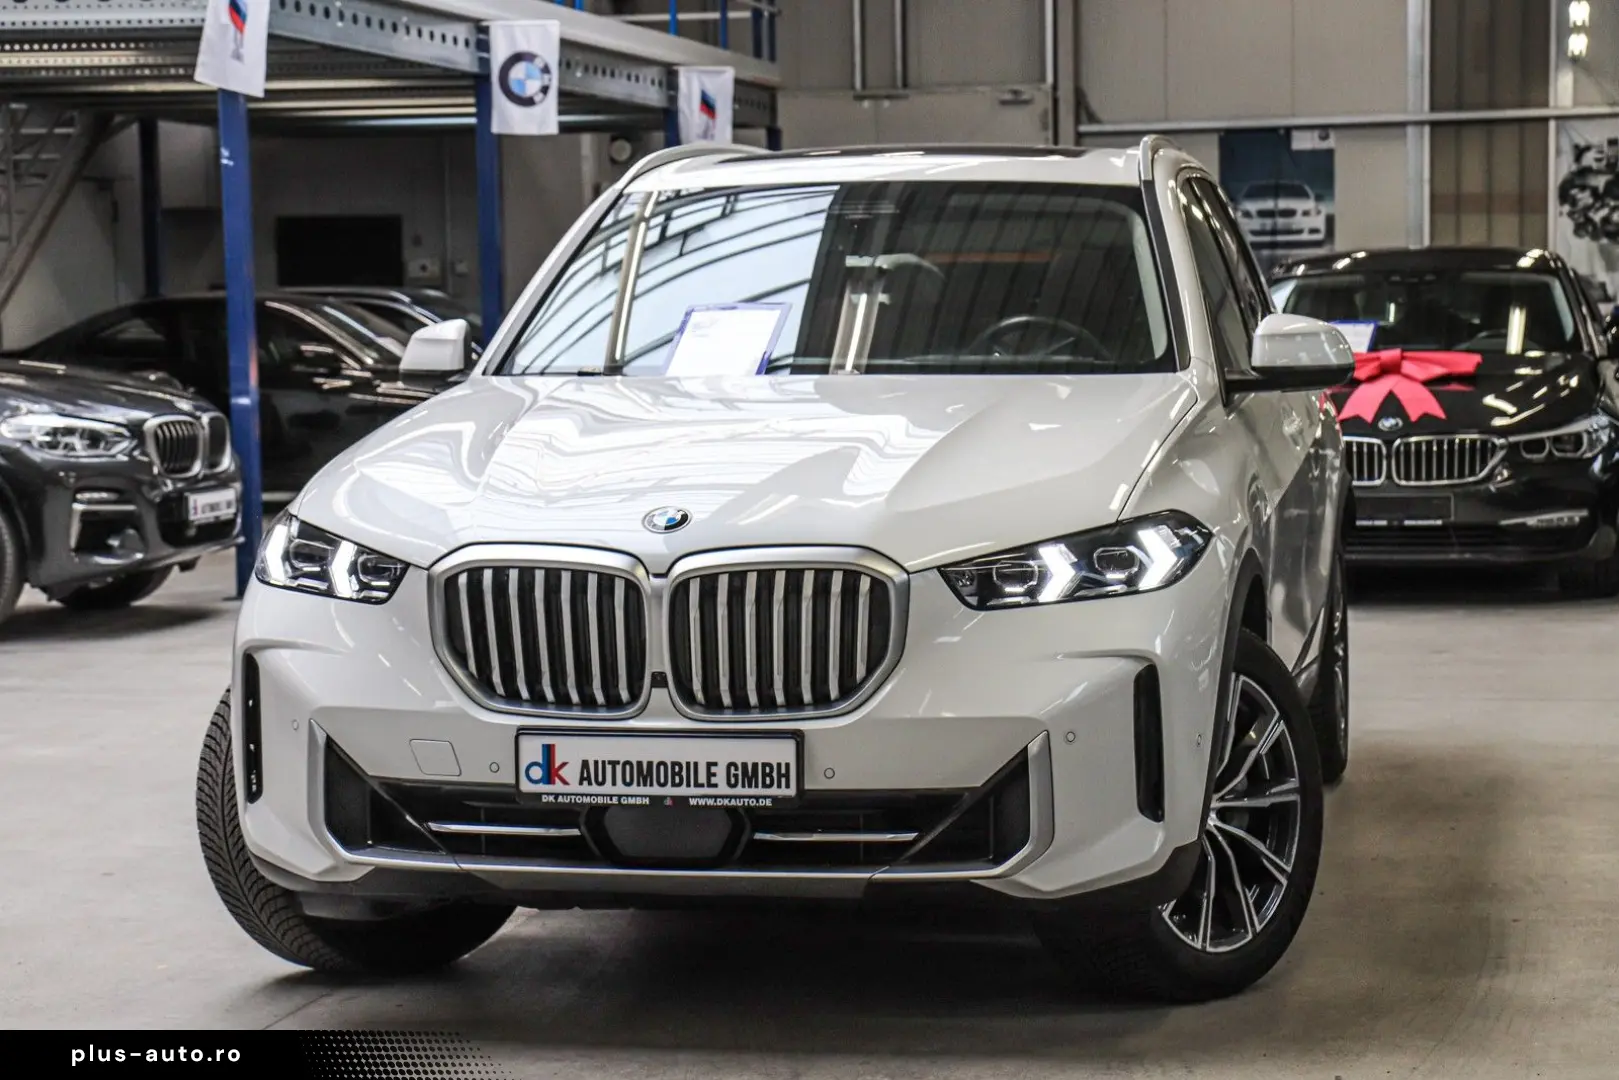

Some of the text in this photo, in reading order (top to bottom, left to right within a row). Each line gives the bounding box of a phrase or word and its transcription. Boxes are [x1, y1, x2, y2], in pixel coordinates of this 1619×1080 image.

[524, 744, 791, 789] dk AUTOMOBILE GMBH
[541, 794, 650, 805] DK AUTOMOBILE GMBH
[688, 797, 773, 807] WWW.DKAUTO.DE
